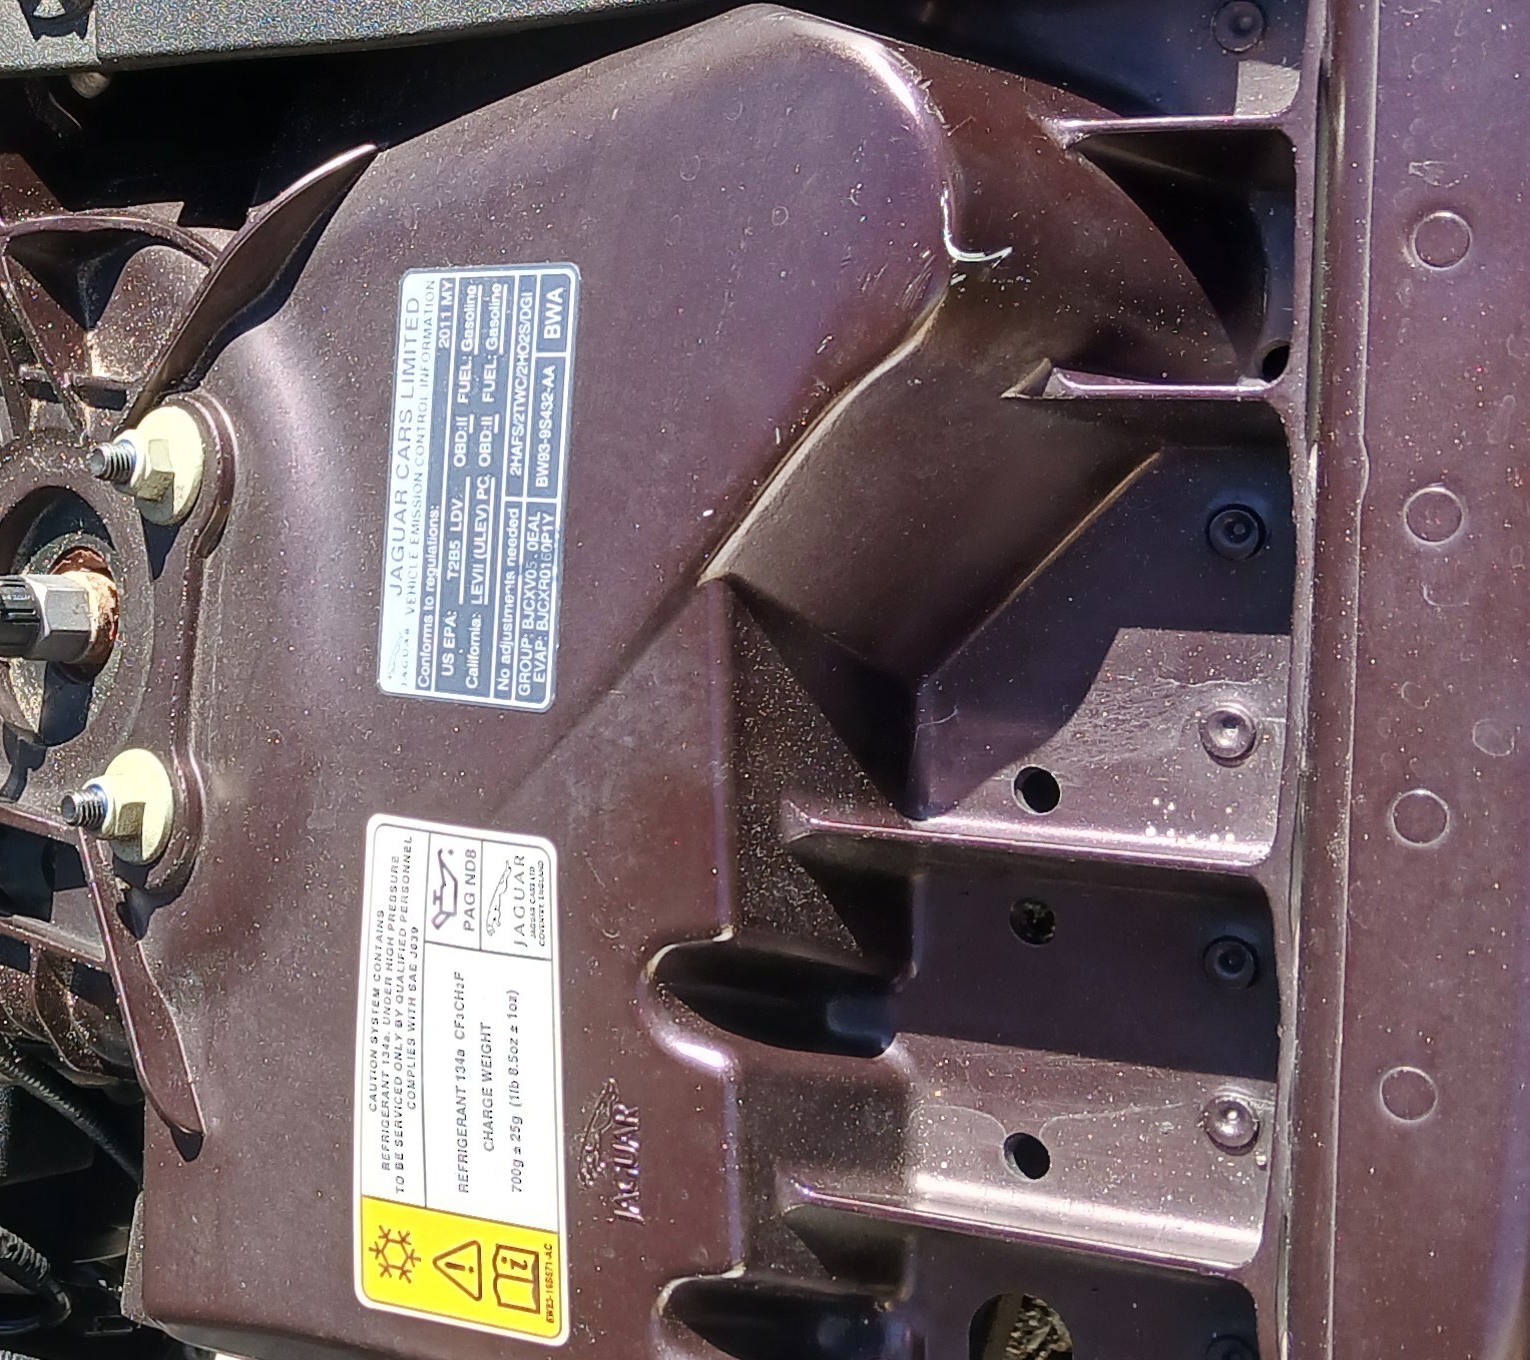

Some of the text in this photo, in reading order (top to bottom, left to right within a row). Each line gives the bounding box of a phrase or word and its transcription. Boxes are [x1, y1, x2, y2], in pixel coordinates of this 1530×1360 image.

[438, 279, 453, 347] 2011 MY
[457, 285, 476, 403] FUEL: Gasoline
[482, 283, 501, 401] FUEL: Gasoline
[544, 287, 563, 338] BWA
[389, 297, 419, 596] JAGUAR CARS LIMITED
[404, 280, 434, 615] VEHICLE EMISSION CONTROL INFORMATION
[535, 365, 554, 487] BW93-9S432-AA
[446, 498, 463, 580] T2B5 LDV
[473, 504, 489, 558] (ULEV)
[417, 505, 441, 687] Conforms to regulations:
[470, 563, 484, 604] LEVII
[496, 508, 519, 690] No adjustments needed
[441, 610, 456, 675] US EPA:
[465, 613, 481, 688] California:
[518, 633, 533, 695] GROUP:
[532, 636, 546, 682] EVAP:
[387, 855, 399, 931] PRESSURE
[463, 848, 476, 931] PAG ND8
[512, 855, 527, 947] JAGUAR
[385, 936, 394, 971] HIGH
[408, 963, 417, 991] SAE
[368, 909, 384, 1112] CAUTION SYSTEM CONTAINS
[382, 976, 392, 1025] UNDER
[393, 836, 412, 1193] TO BE SERVICED ONLY BY QUALIFIED PERSONNEL
[407, 996, 416, 1032] WITH
[506, 989, 519, 1018] 1oz)
[406, 1037, 416, 1110] COMPLIES
[454, 1048, 465, 1080] 134a
[479, 1021, 494, 1152] CHARGE WEIGHT
[507, 1037, 518, 1076] 8.5oz
[380, 1070, 390, 1170] REFRIGERANT
[455, 1085, 468, 1193] REFRIGERANT
[509, 1115, 523, 1142] 25g
[510, 1158, 524, 1192] 700g
[611, 1103, 646, 1226] JAGUAR
